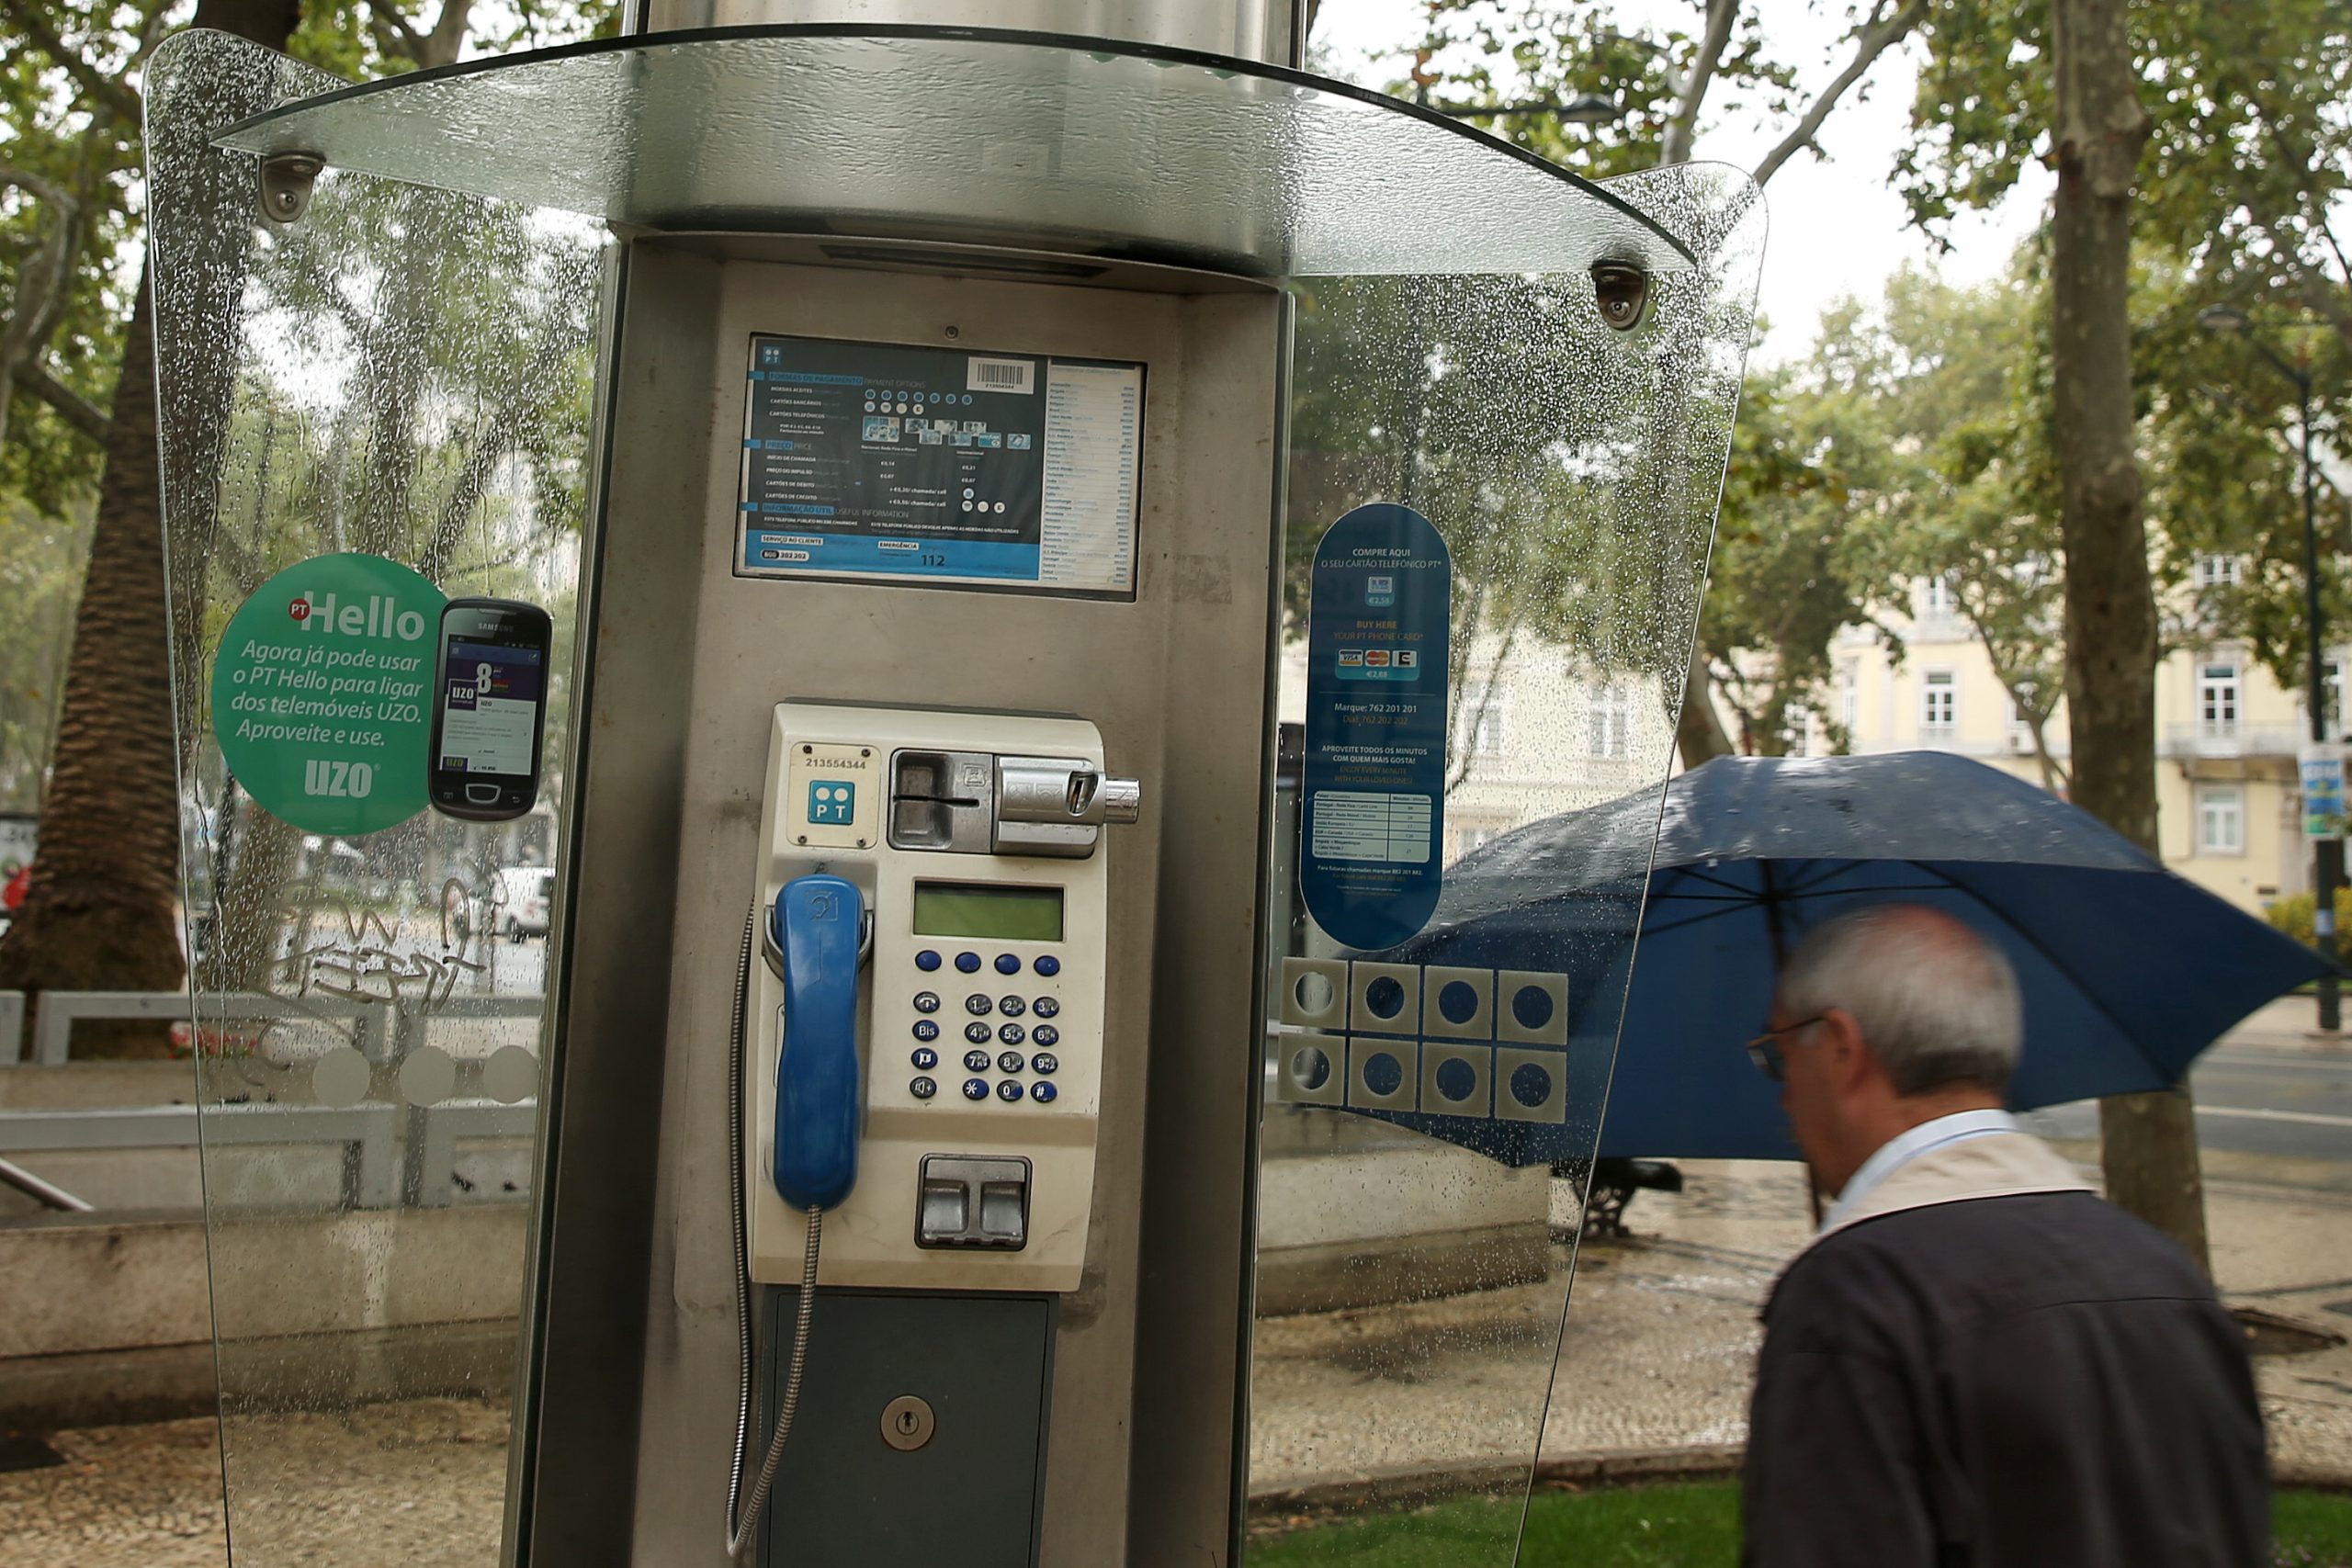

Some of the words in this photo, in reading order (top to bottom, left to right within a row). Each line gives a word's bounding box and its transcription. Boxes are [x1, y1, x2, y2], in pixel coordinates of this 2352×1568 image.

[763, 536, 787, 544] SERVIÇO
[797, 537, 822, 546] CLIENTE
[1351, 548, 1387, 558] COMPRE
[1388, 549, 1411, 558] AQUI
[921, 555, 945, 567] 112
[1320, 559, 1329, 569] O
[1329, 559, 1345, 569] SEU
[1345, 559, 1377, 570] CARTÃO
[289, 603, 307, 615] PT
[300, 590, 425, 640] Hello
[1356, 621, 1374, 630] BUY
[1375, 621, 1397, 630] HERE
[241, 639, 301, 663] Agora
[304, 645, 324, 667] já
[325, 647, 377, 670] pode
[379, 655, 423, 672] usar
[232, 670, 246, 684] o
[248, 667, 277, 687] PT
[277, 669, 329, 690] Hello
[329, 675, 377, 695] para
[379, 680, 424, 701] ligar
[231, 691, 266, 713] dos
[269, 693, 373, 720] telemóveis
[377, 704, 423, 724] UZO.
[1334, 703, 1368, 713] Marque:
[1369, 705, 1385, 714] 762
[1385, 705, 1401, 714] 201
[1402, 705, 1418, 714] 201
[235, 717, 332, 743] Aproveite
[334, 729, 346, 743] e
[348, 730, 386, 747] use.
[1360, 747, 1384, 755] TODOS
[805, 758, 866, 771] 213554344
[1332, 755, 1350, 763] COM
[1350, 756, 1371, 764] QUEM
[1005, 1000, 1012, 1011] 2
[1038, 1002, 1046, 1012] 3
[919, 1025, 935, 1036] Bis
[970, 1028, 978, 1038] 4
[1004, 1029, 1012, 1040] 5
[1037, 1031, 1045, 1040] 6
[969, 1056, 978, 1066] 7
[1003, 1057, 1011, 1067] 8
[1037, 1059, 1045, 1069] 9
[1003, 1086, 1011, 1096] 0
